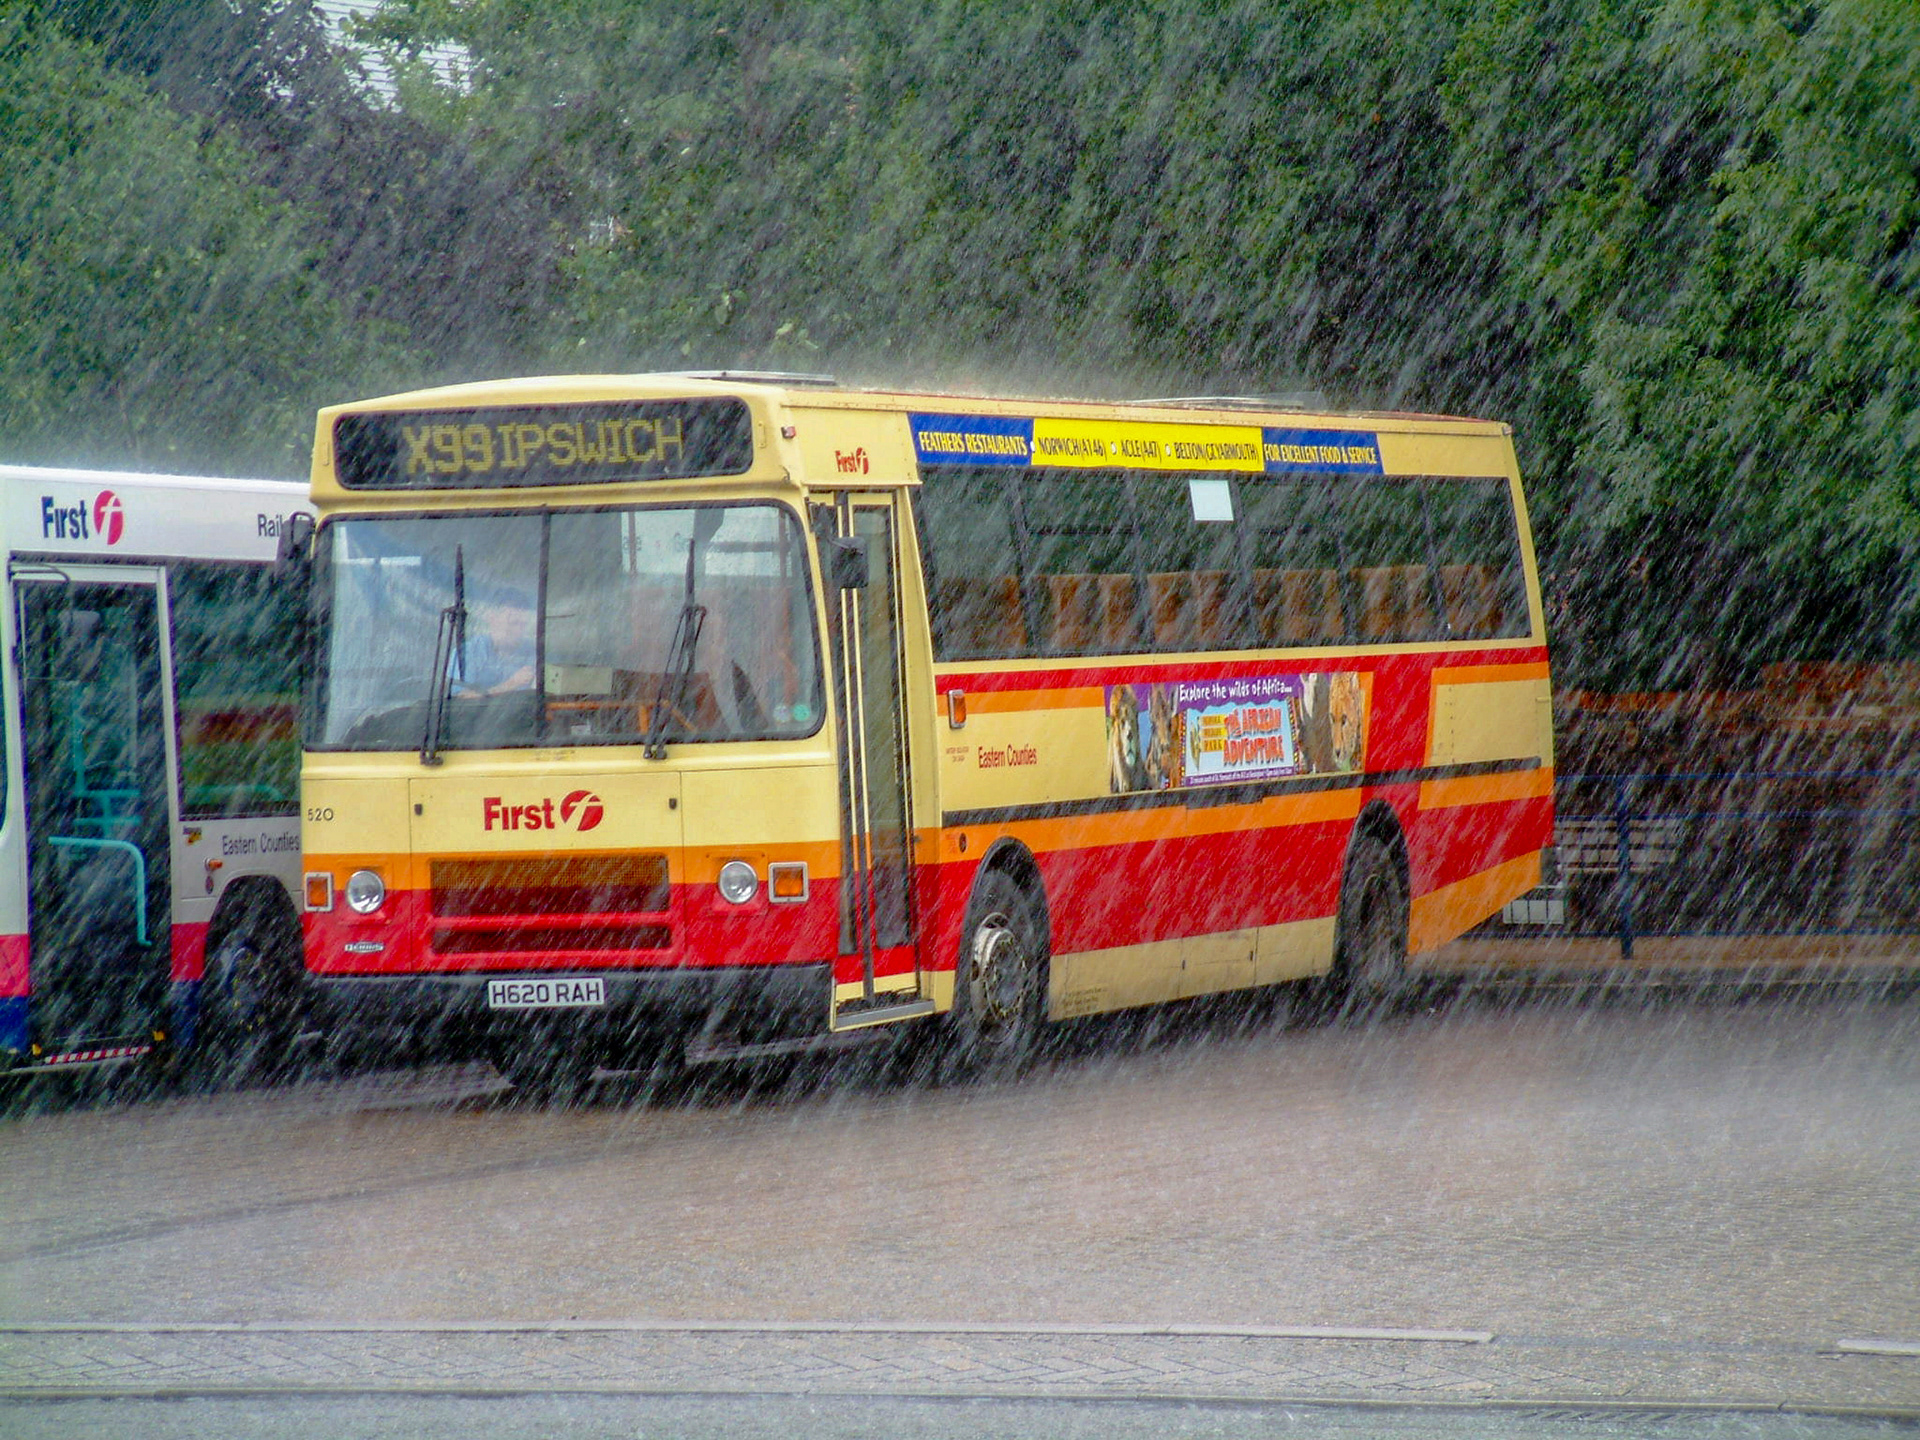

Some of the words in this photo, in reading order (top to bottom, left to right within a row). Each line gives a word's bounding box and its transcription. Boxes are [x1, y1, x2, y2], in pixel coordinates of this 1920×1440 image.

[402, 423, 494, 474] X99
[499, 418, 684, 468] IPSWICH
[918, 431, 965, 452] FEATHERS
[965, 433, 1028, 456] RESTAURANTS
[1264, 443, 1281, 461] FOR
[1280, 445, 1319, 463] EXCELLENT
[1320, 446, 1341, 463] FOOD
[1348, 447, 1377, 464] SERVICE
[835, 450, 857, 472] First
[41, 496, 88, 540] First
[1179, 684, 1211, 702] Explore
[1212, 682, 1227, 699] the
[1229, 681, 1250, 698] wilds
[1251, 680, 1262, 696] of
[978, 746, 1006, 769] Eastern
[1007, 744, 1038, 767] Counties
[307, 808, 334, 822] 520
[483, 797, 555, 831] First
[222, 834, 257, 856] Eastern
[259, 832, 300, 853] Counties
[492, 984, 550, 1004] H620
[555, 982, 601, 1003] RAH
